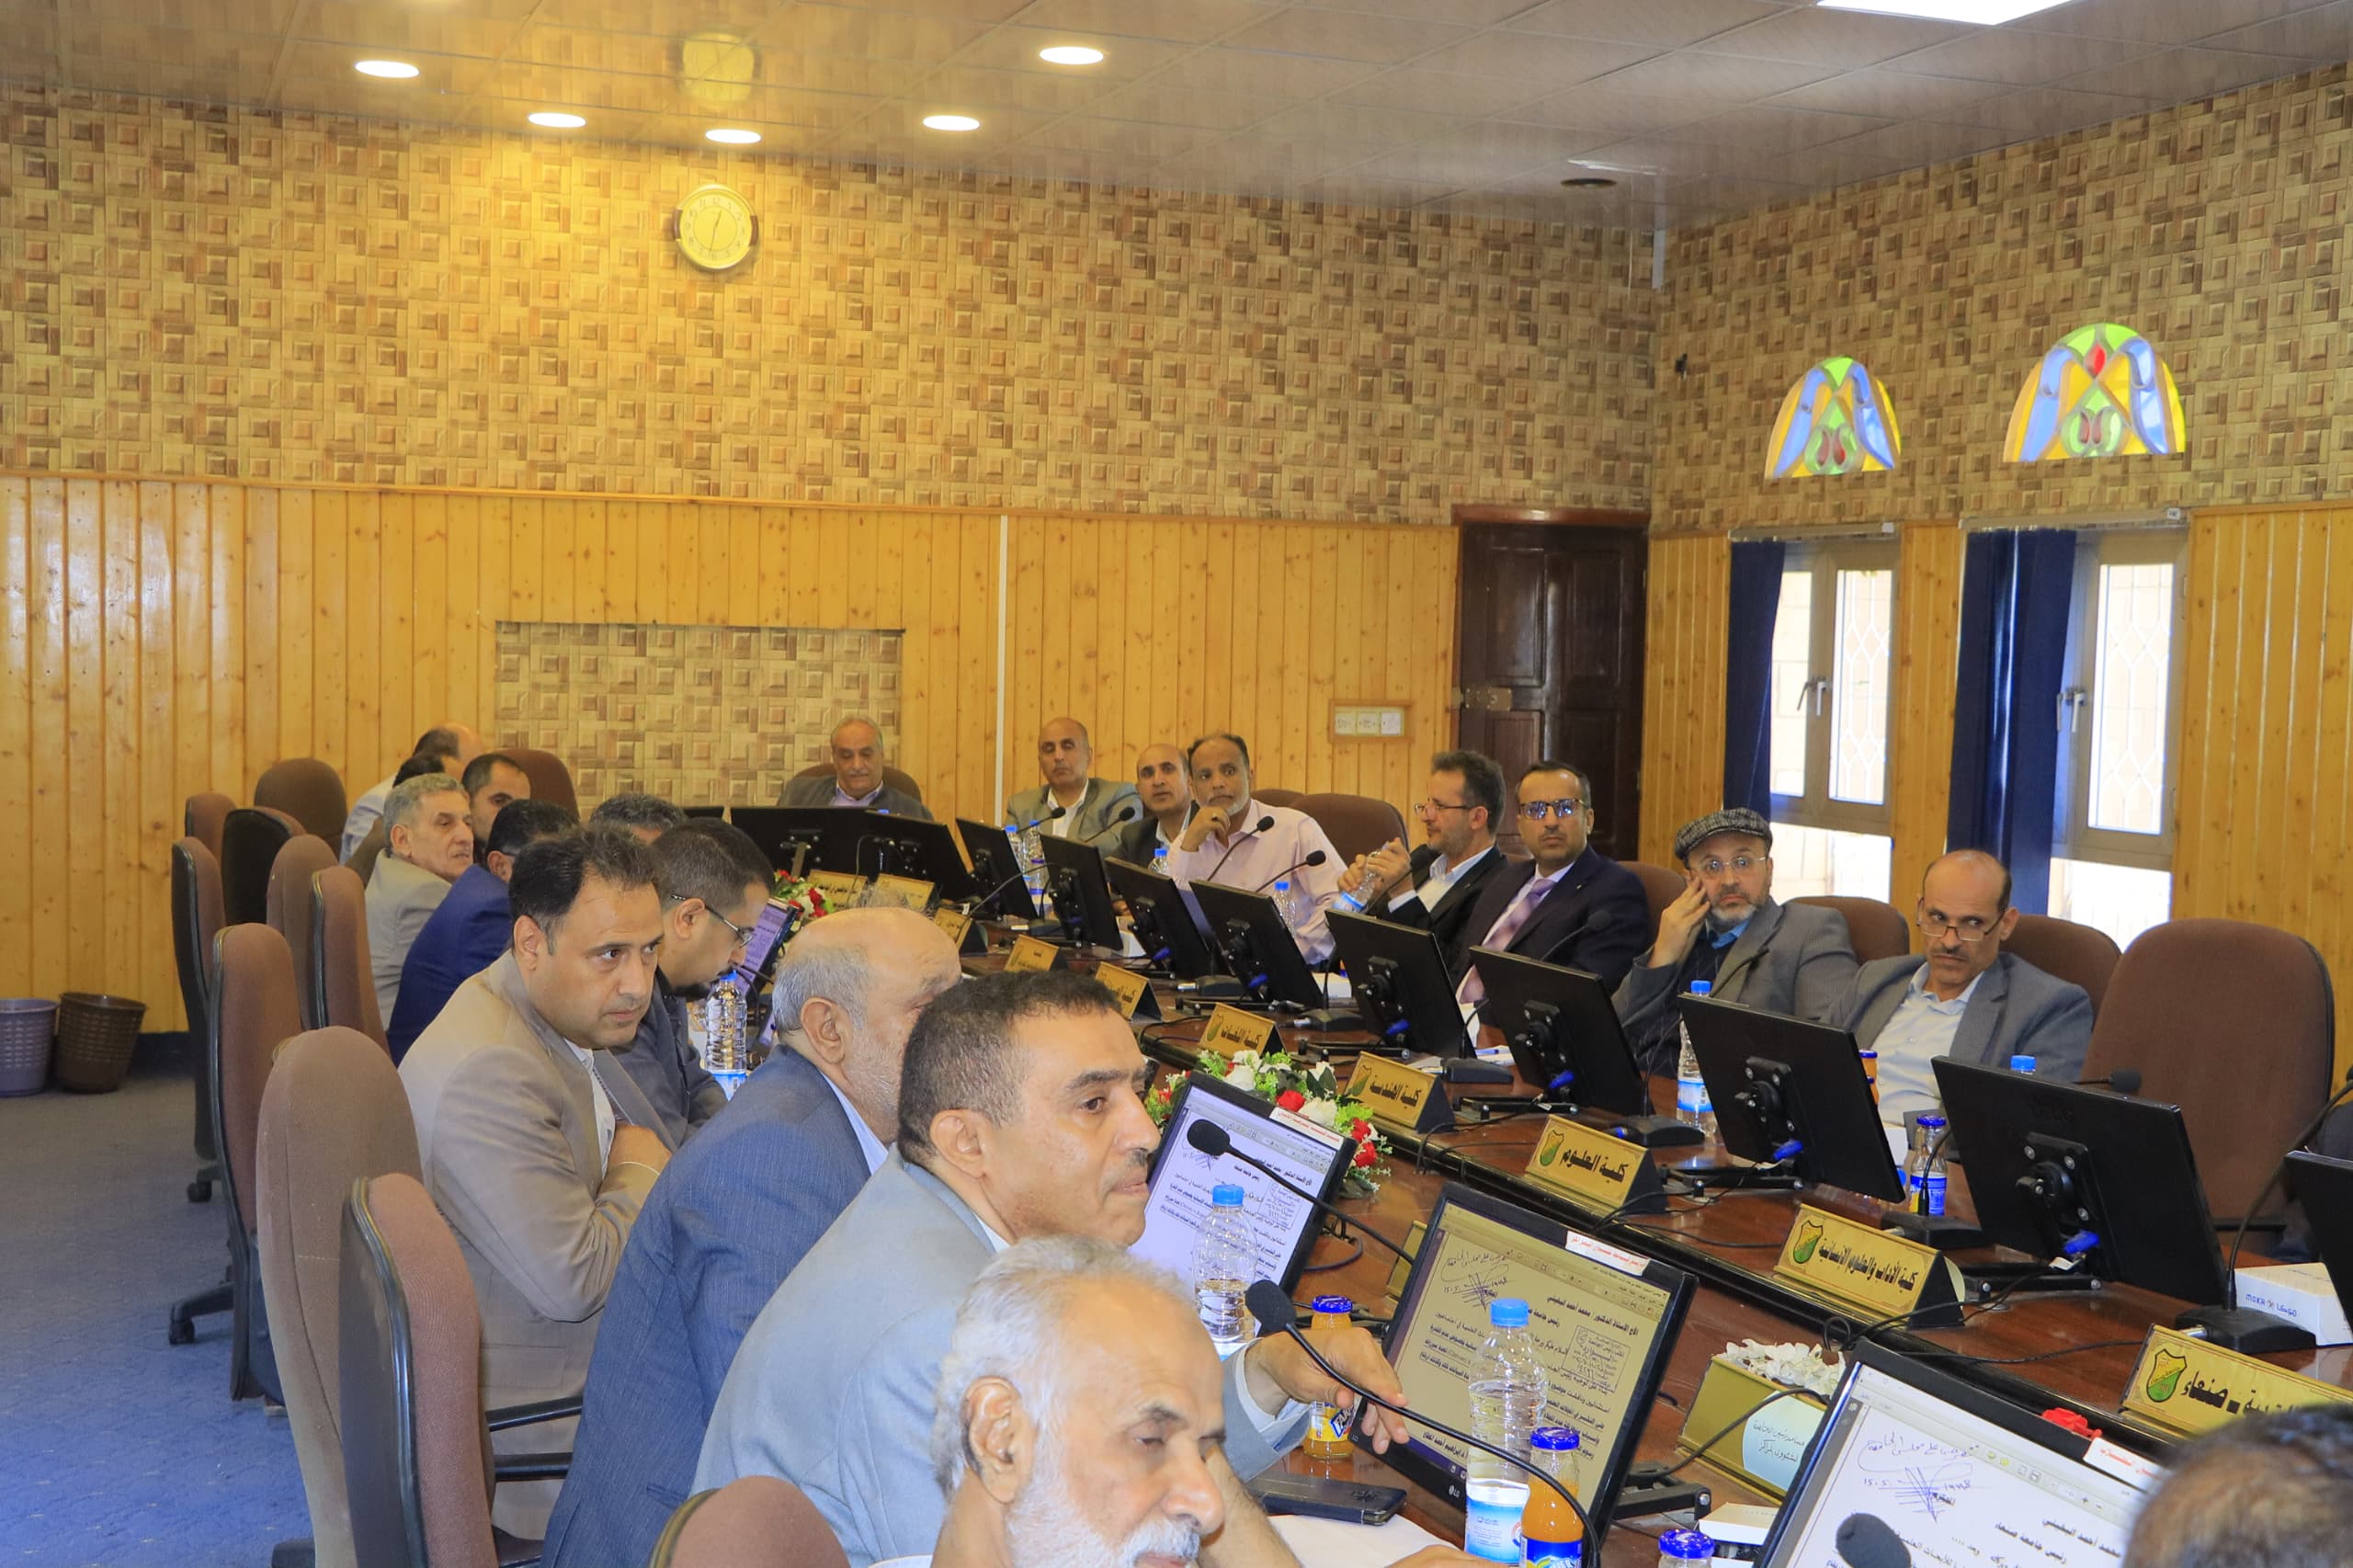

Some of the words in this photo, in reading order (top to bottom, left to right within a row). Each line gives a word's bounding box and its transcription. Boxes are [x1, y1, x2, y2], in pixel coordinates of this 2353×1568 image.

[1370, 1074, 1404, 1101] الهندسة
[1400, 1085, 1422, 1108] كلية
[1559, 1148, 1602, 1173] العلوم
[1598, 1156, 1629, 1184] كلية
[1897, 1267, 1919, 1293] كلية
[2180, 1369, 2229, 1409] صنعاء
